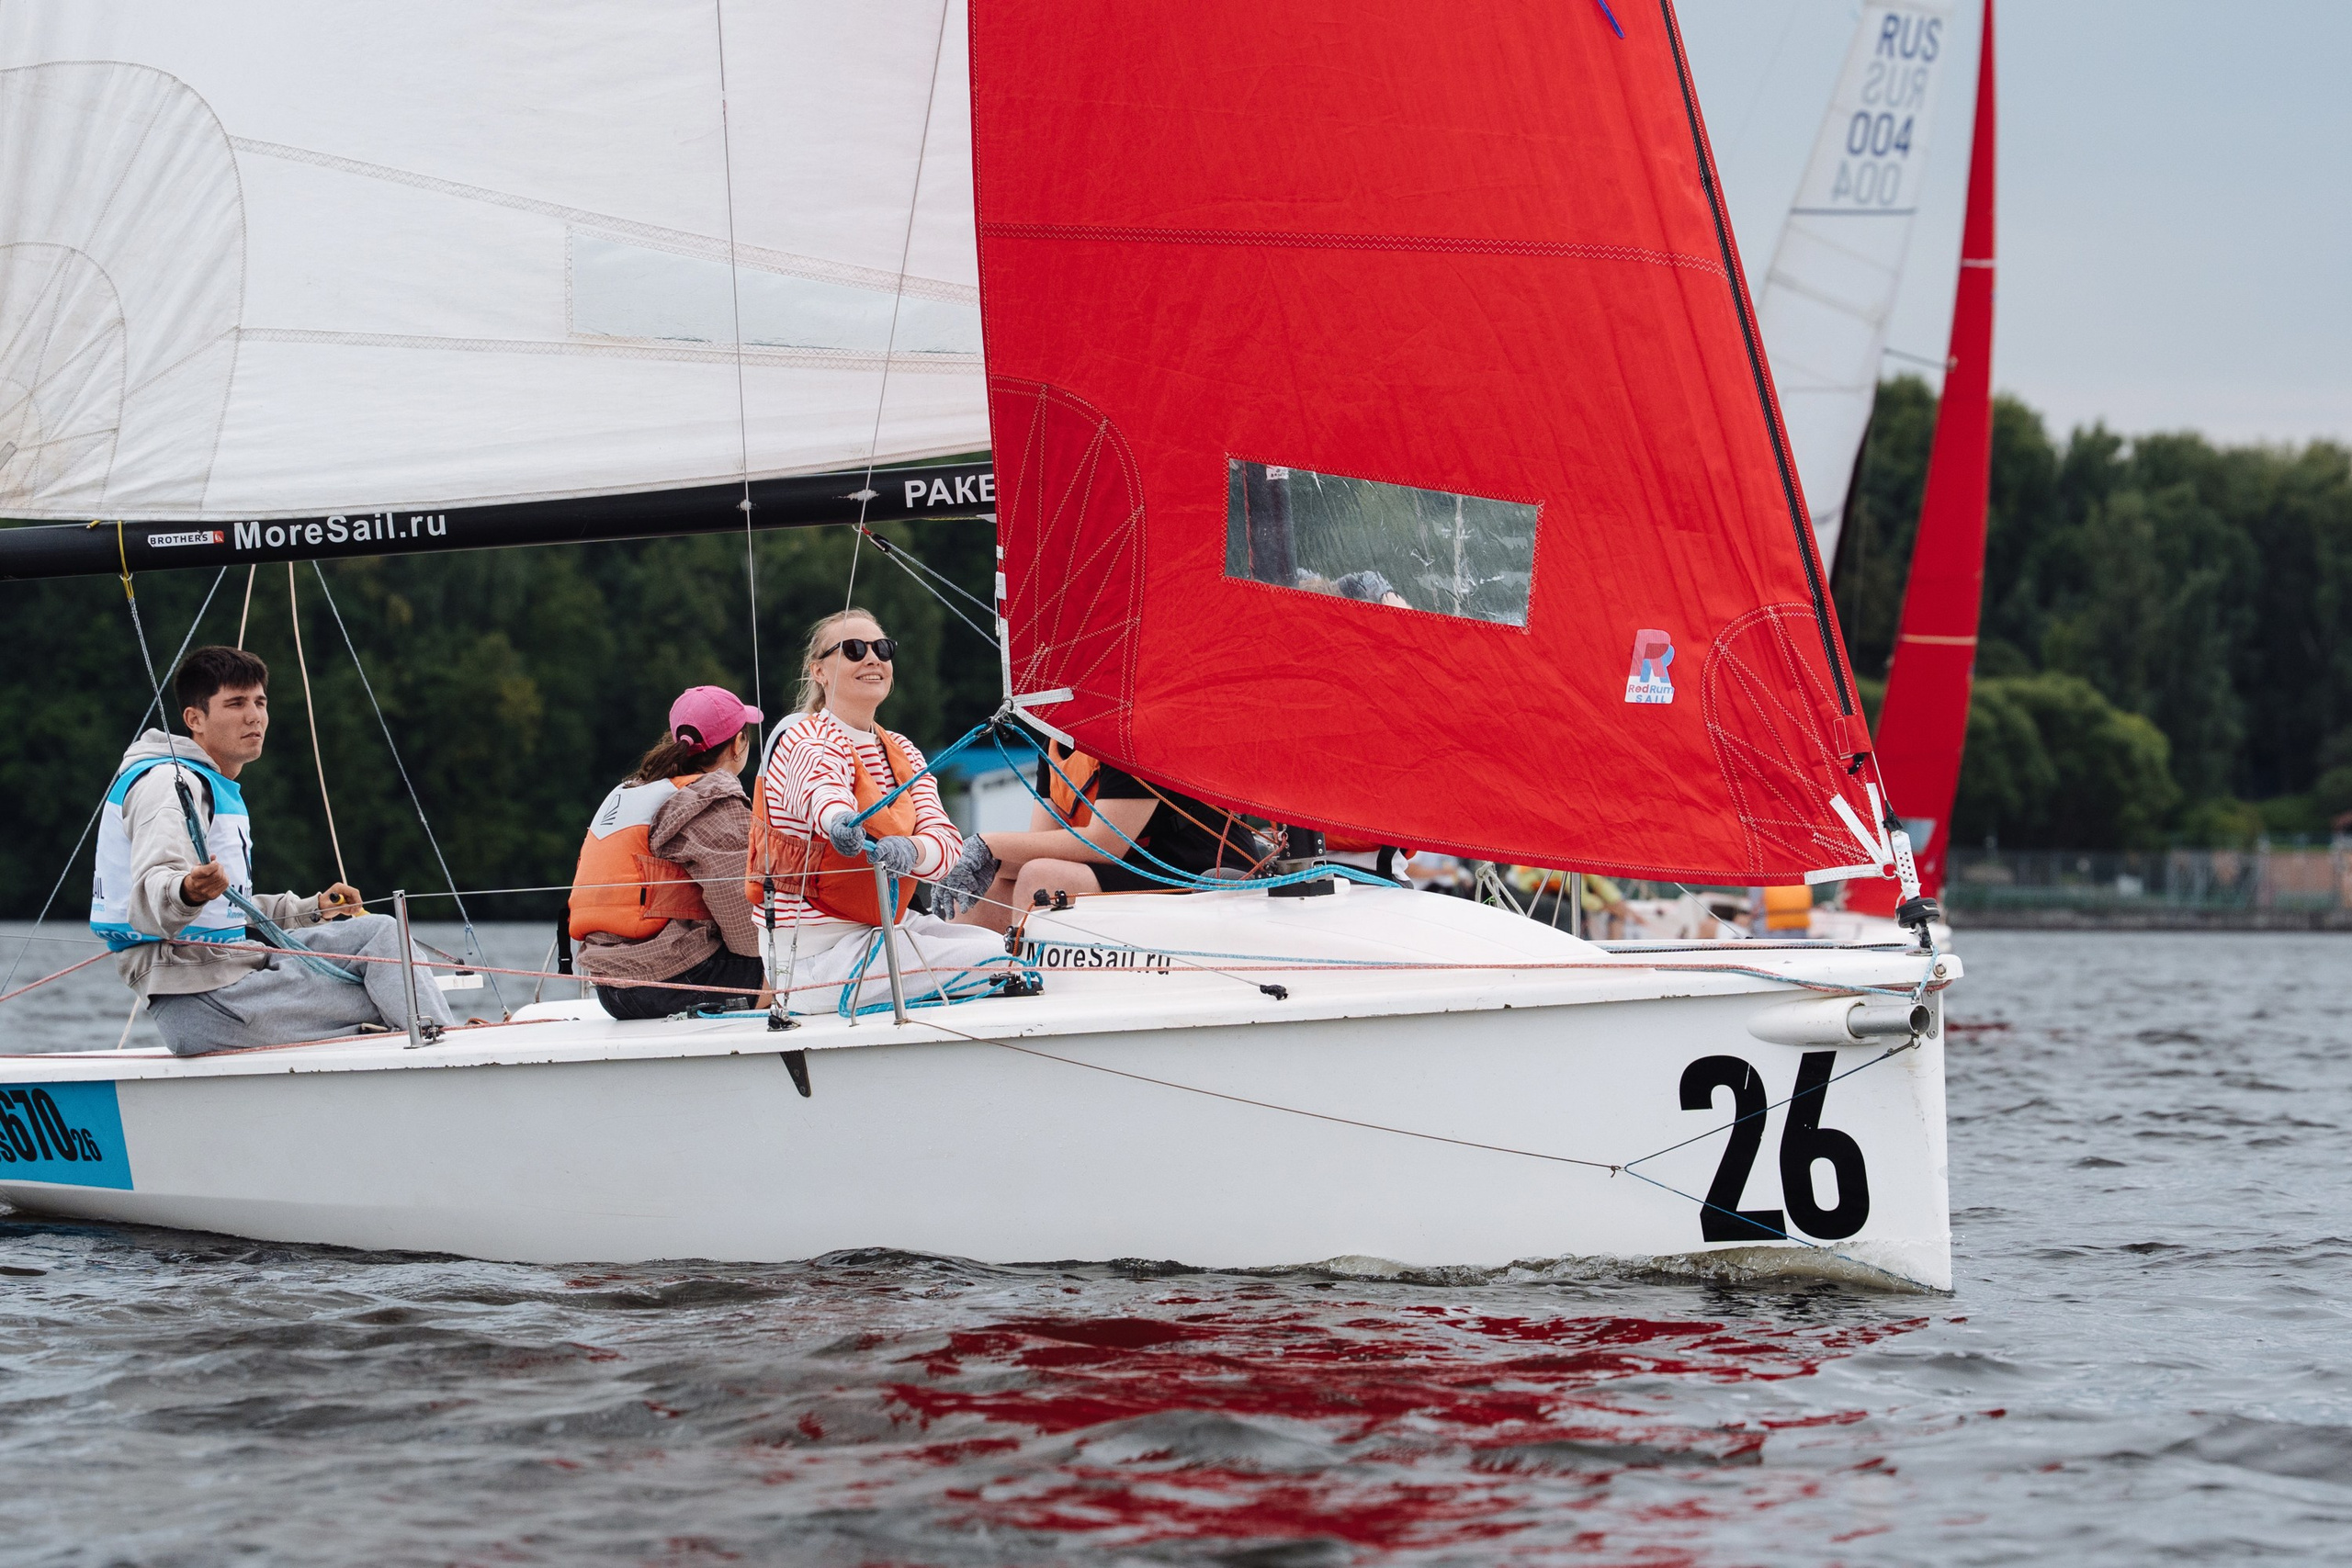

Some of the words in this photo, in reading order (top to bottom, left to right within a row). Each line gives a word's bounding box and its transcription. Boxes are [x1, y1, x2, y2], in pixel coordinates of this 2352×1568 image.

[1877, 14, 1942, 62] RUS
[1847, 111, 1915, 159] 004
[150, 534, 209, 545] BROTHERS
[233, 512, 447, 550] MoreSail.ru
[1628, 684, 1674, 694] RedRum
[1635, 694, 1667, 703] SAIL
[1026, 942, 1170, 975] MoreSailru
[1679, 1051, 1870, 1242] 26
